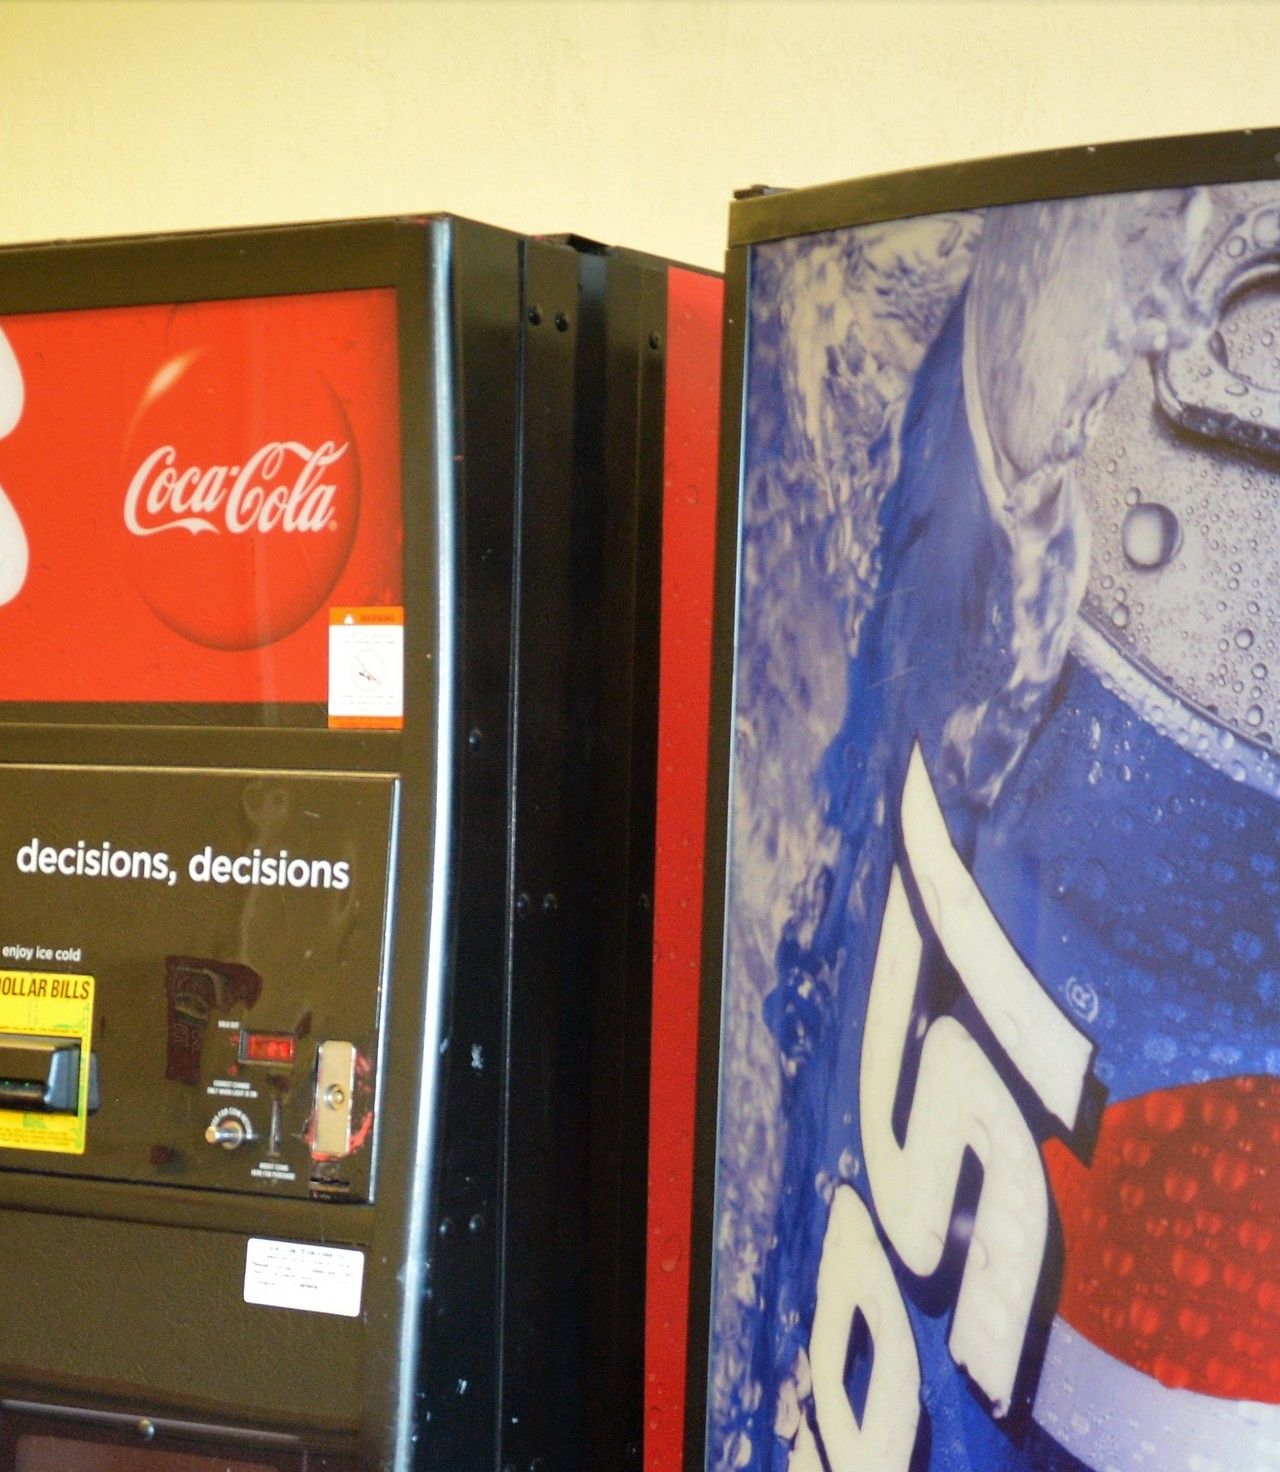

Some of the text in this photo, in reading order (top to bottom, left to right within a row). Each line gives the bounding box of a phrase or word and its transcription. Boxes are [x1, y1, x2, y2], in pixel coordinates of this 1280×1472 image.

[124, 440, 349, 536] Coca-Cola
[16, 838, 350, 890] decisions, decisions
[2, 944, 81, 961] enjoy ice cold
[51, 979, 90, 999] BILLS
